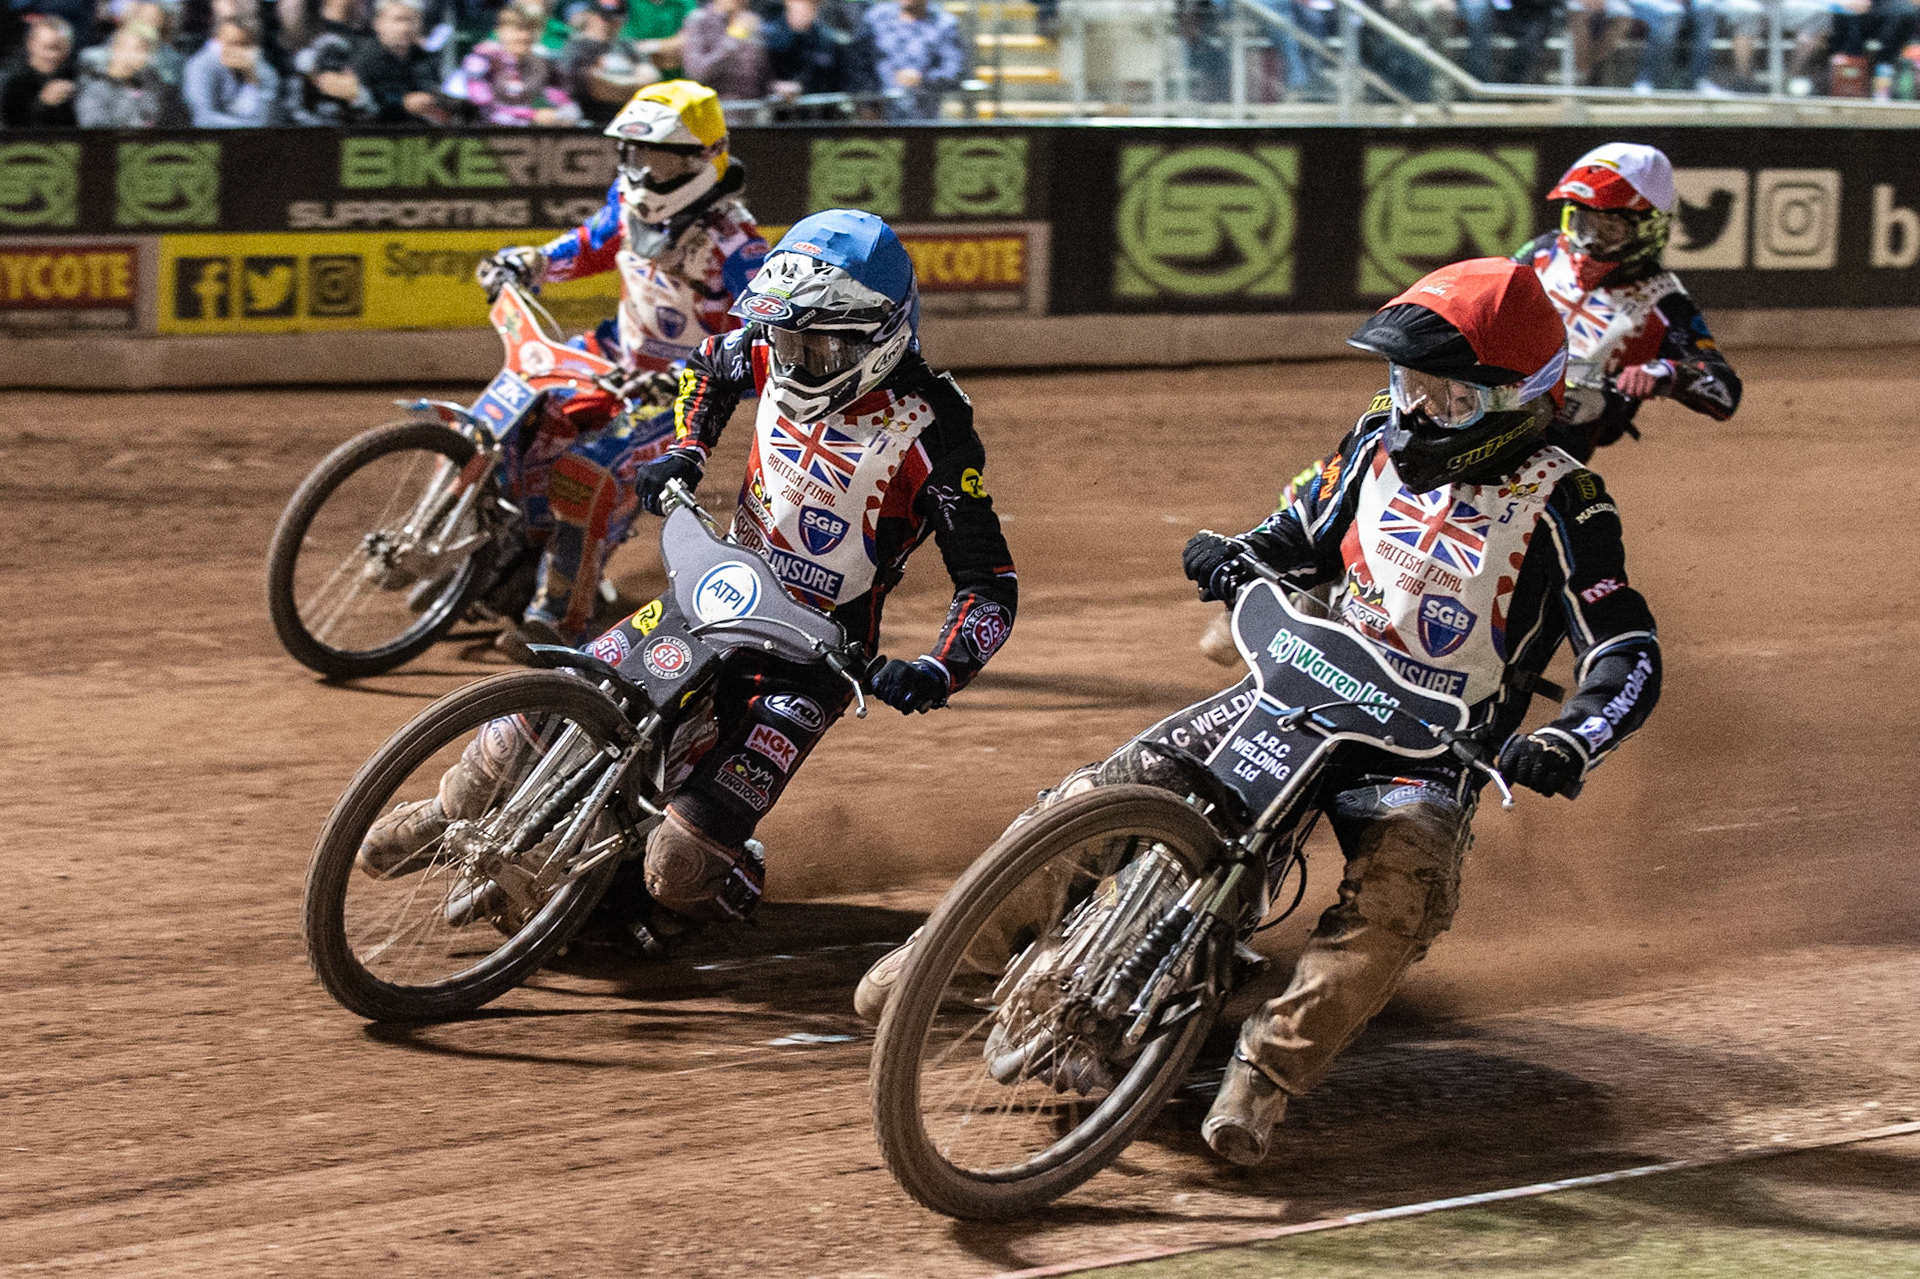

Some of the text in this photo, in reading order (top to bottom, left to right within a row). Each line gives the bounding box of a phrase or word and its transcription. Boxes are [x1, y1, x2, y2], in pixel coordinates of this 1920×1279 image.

[747, 298, 784, 314] STS
[766, 453, 836, 507] BRITISH FINAL
[780, 484, 805, 507] 2019
[803, 510, 844, 536] SGB
[1498, 502, 1519, 524] 5
[771, 553, 839, 596] INSURE
[1375, 539, 1463, 593] BRITISH FINAL
[707, 578, 745, 610] ATPI
[1395, 572, 1426, 597] 2019
[1424, 599, 1470, 631] SGB
[980, 617, 1000, 648] STS
[596, 639, 619, 664] STS
[654, 647, 679, 667] STS
[1291, 640, 1362, 701] Warren
[752, 727, 795, 765] NGK
[1230, 735, 1291, 781] WELDING
[1251, 730, 1291, 759] A.R.C
[1232, 759, 1262, 782] Ltd
